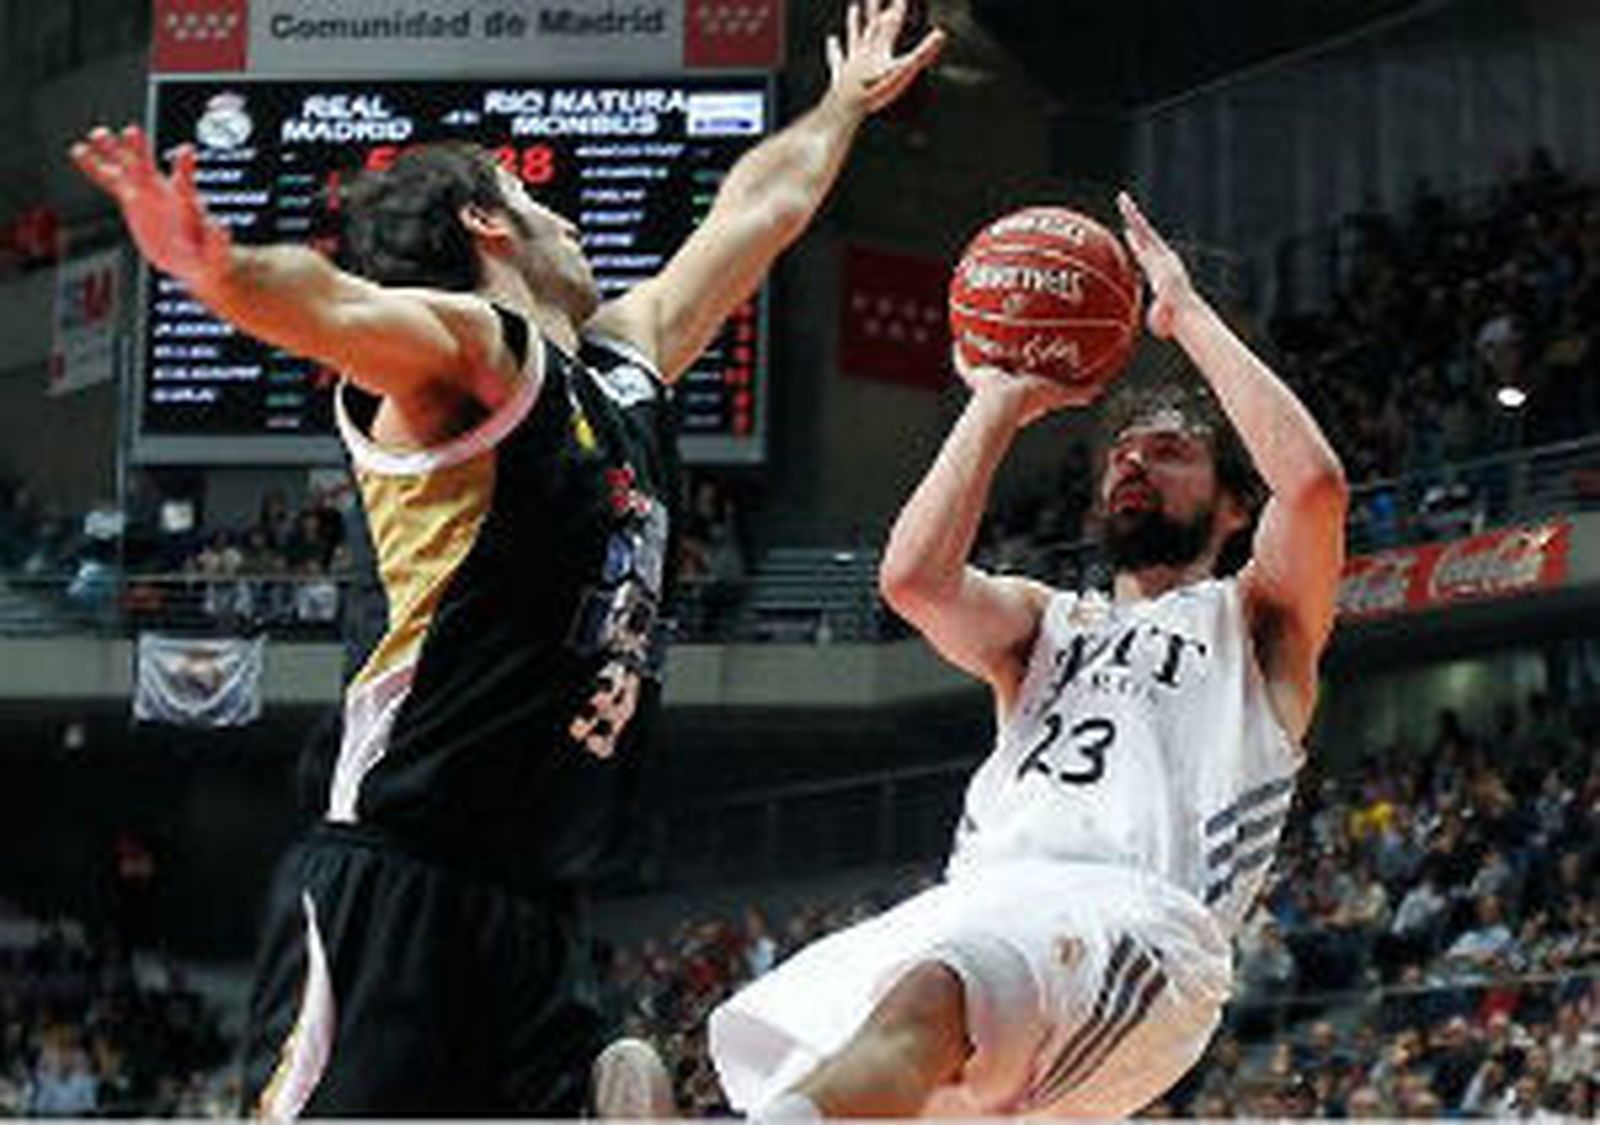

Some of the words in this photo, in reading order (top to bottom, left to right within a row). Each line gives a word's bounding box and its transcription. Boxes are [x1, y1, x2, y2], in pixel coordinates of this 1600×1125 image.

[270, 9, 471, 39] Comunidad
[484, 12, 527, 38] de
[538, 7, 665, 36] Madrid
[302, 94, 391, 120] REAL
[484, 90, 545, 114] RIO
[551, 88, 687, 114] NATURA
[280, 117, 414, 144] MADRID
[510, 113, 658, 136] MONBUS
[1016, 713, 1117, 786] 23
